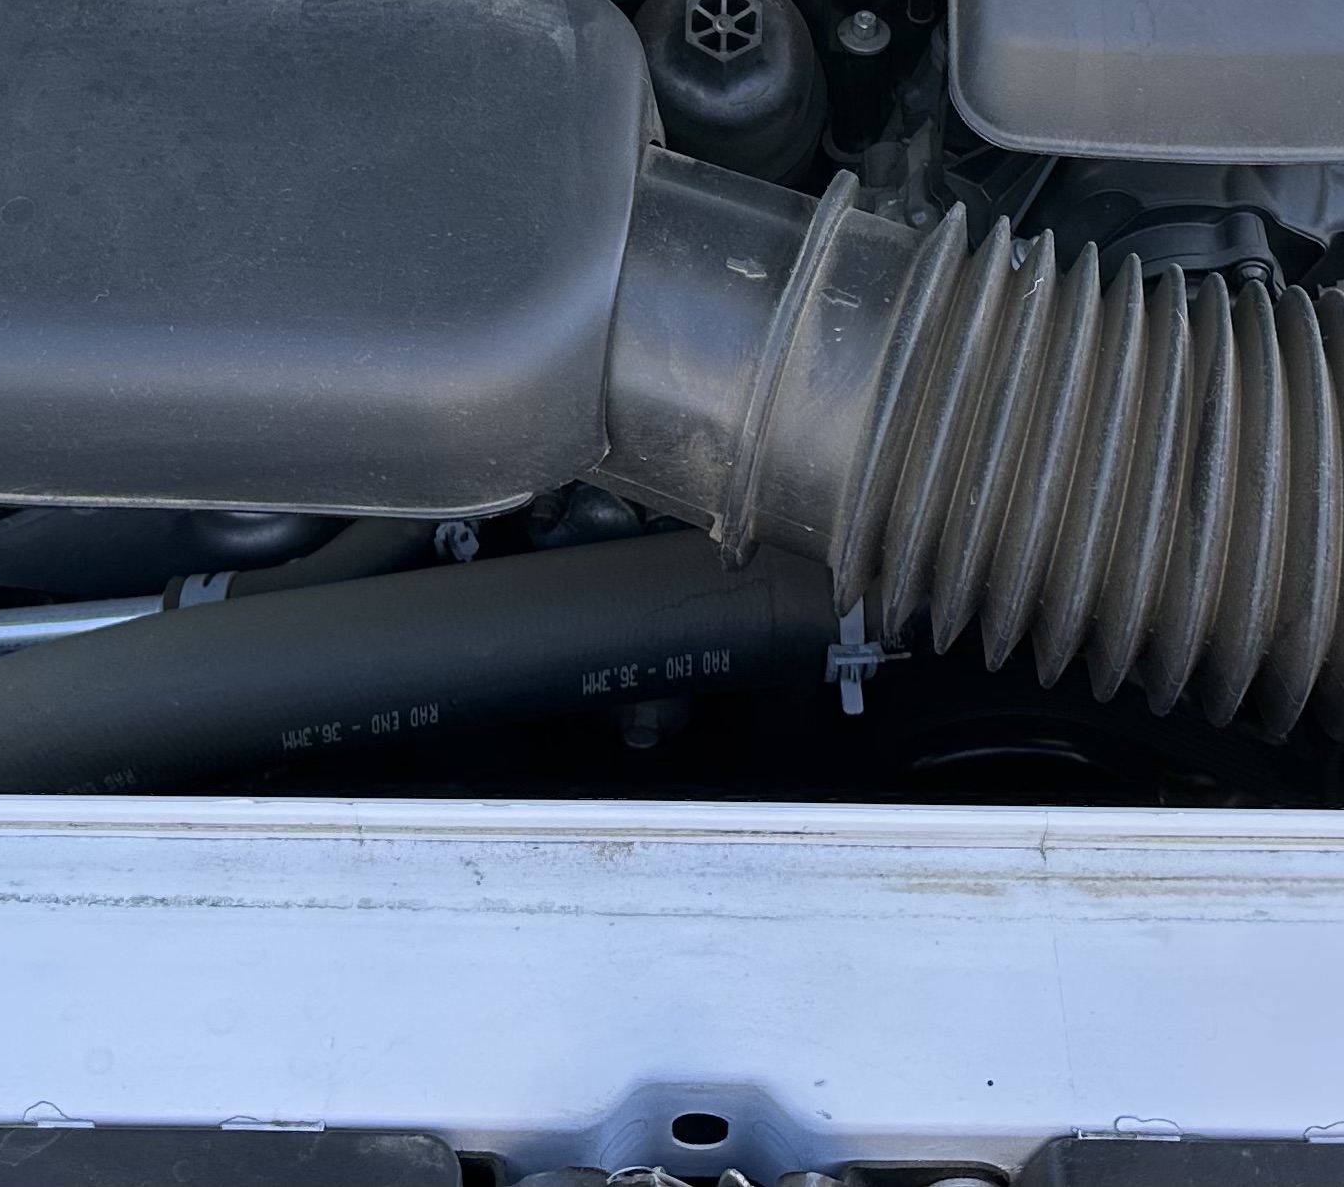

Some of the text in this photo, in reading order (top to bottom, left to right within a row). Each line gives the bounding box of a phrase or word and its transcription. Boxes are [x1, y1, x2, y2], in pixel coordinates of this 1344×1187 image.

[666, 654, 692, 680] END
[702, 649, 730, 675] RAD
[582, 663, 639, 696] 36.3MM
[371, 710, 400, 734] END
[410, 703, 439, 727] RAD
[281, 722, 343, 750] 36.3MM
